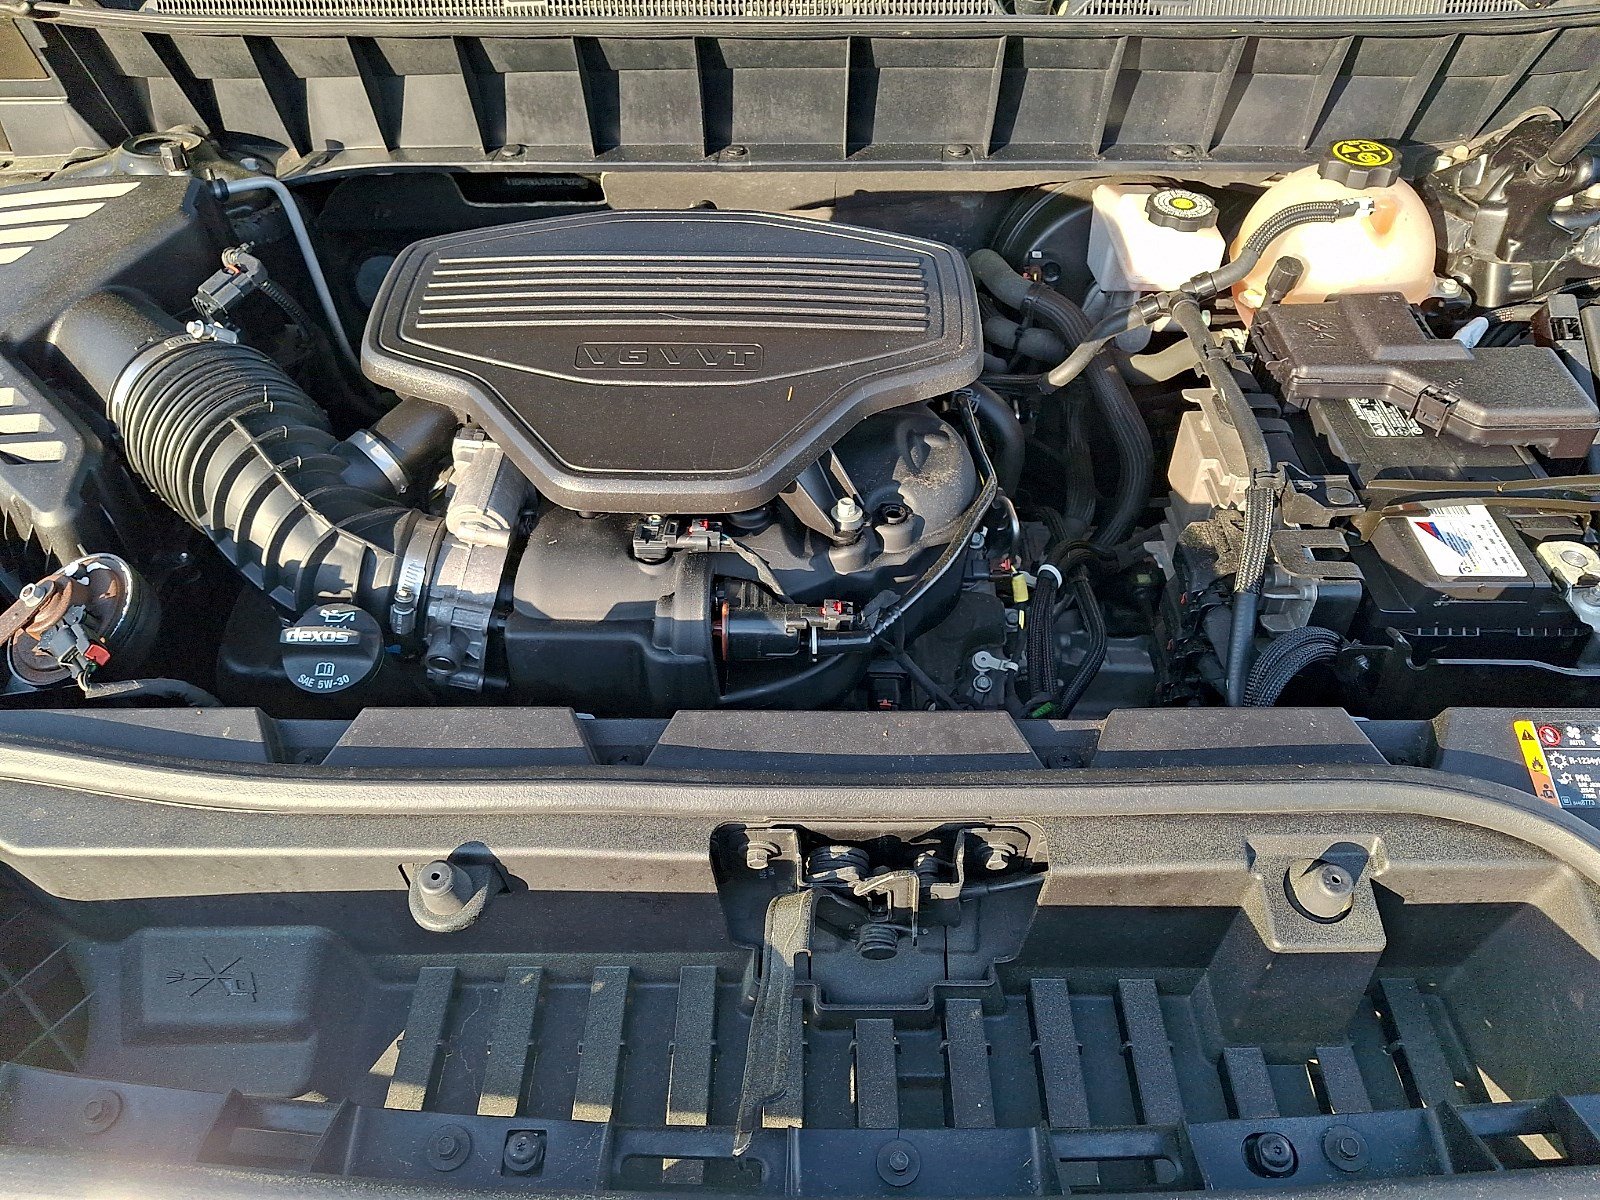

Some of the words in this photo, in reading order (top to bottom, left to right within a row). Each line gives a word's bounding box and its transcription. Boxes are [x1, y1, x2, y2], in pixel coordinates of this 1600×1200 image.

[584, 347, 649, 365] V6
[659, 347, 756, 367] VVT
[286, 628, 350, 642] dexos
[297, 674, 316, 688] SAE
[317, 674, 350, 689] 5W-30
[1568, 756, 1600, 766] R-1234y
